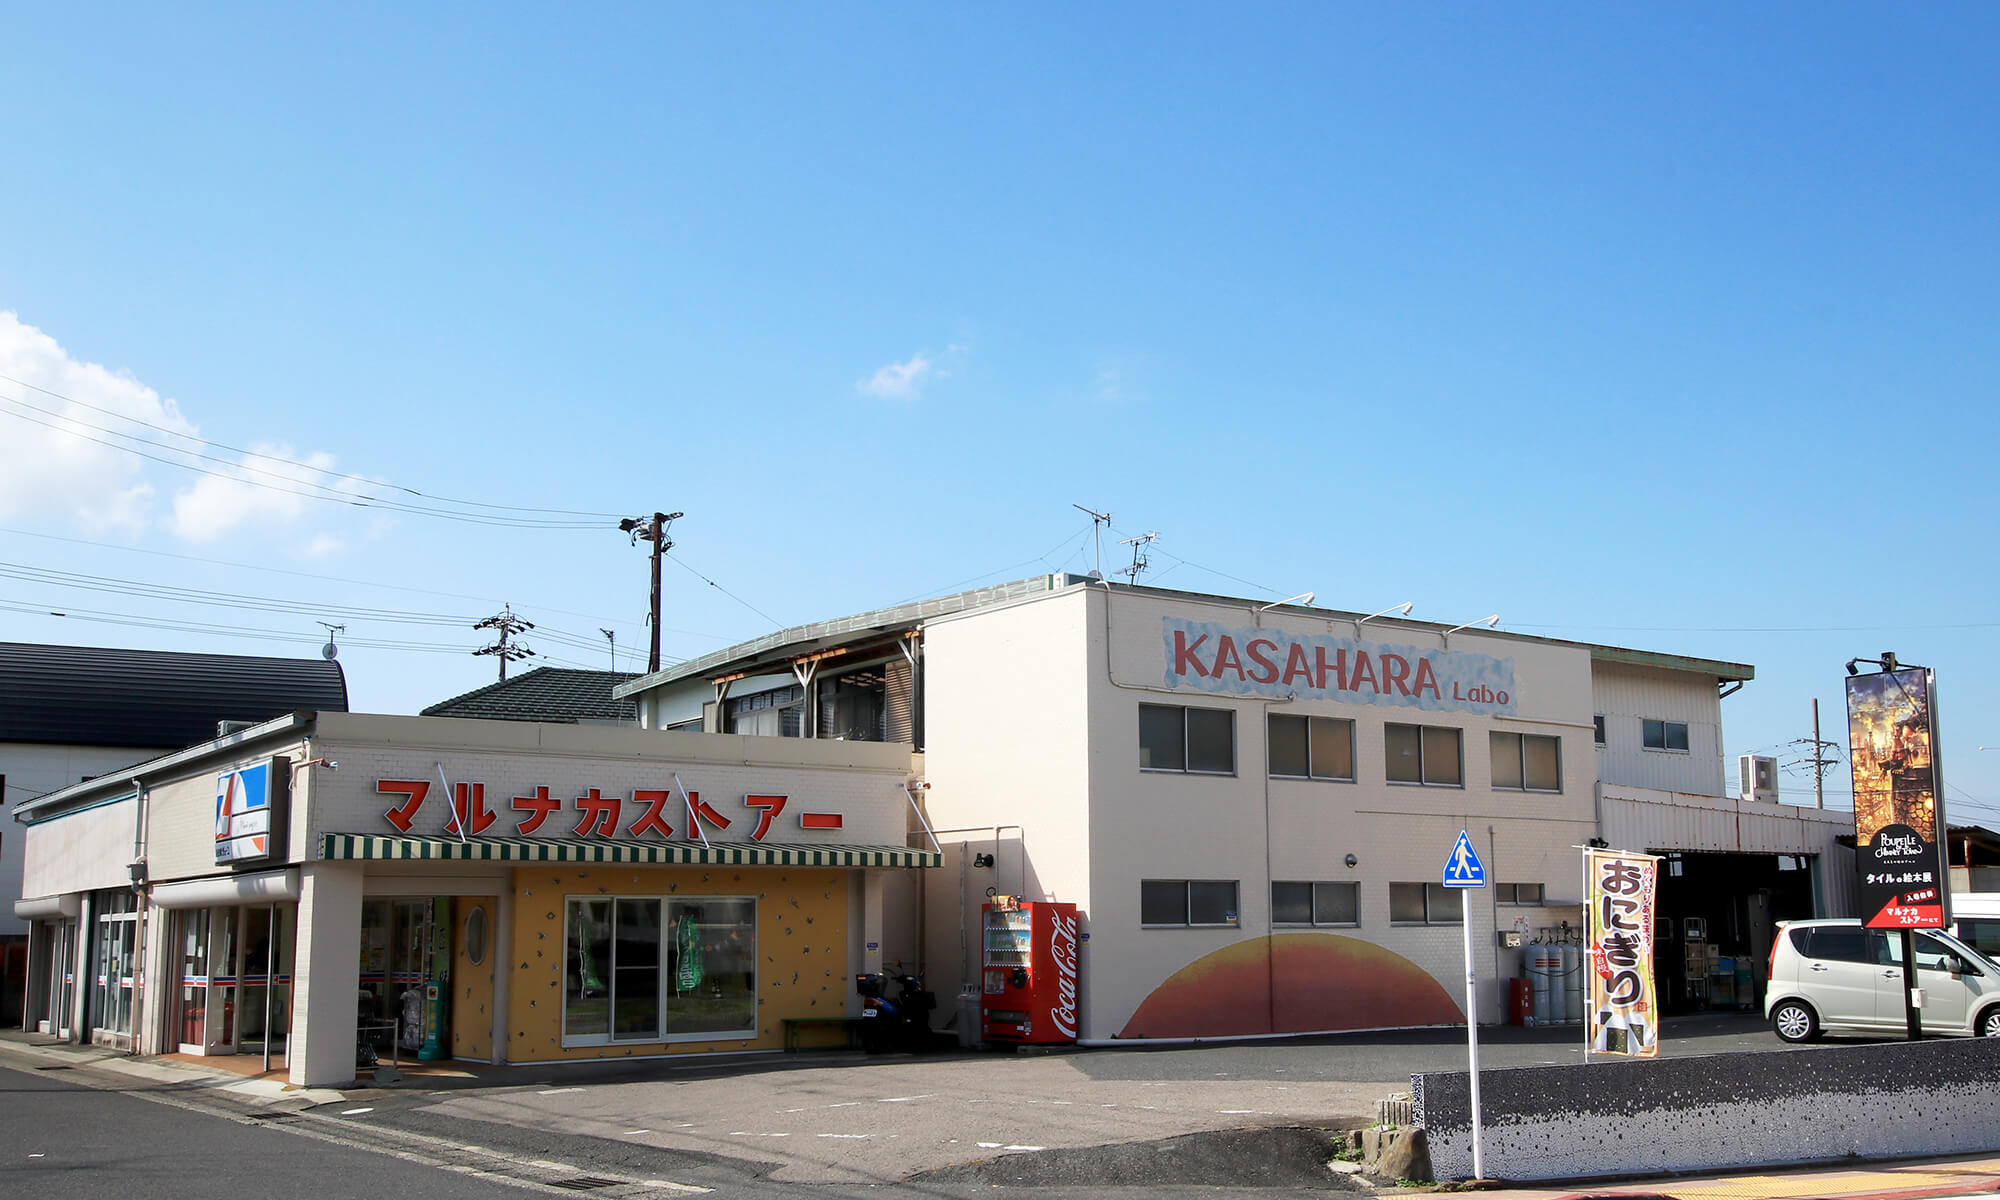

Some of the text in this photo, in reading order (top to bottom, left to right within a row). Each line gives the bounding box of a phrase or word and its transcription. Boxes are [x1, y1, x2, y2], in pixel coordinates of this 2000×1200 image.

[1174, 630, 1509, 705] KASAHARA Labo
[376, 779, 844, 841] マルナカストアー
[1602, 860, 1641, 1004] おにぎり
[1886, 907, 1918, 916] マルナカ
